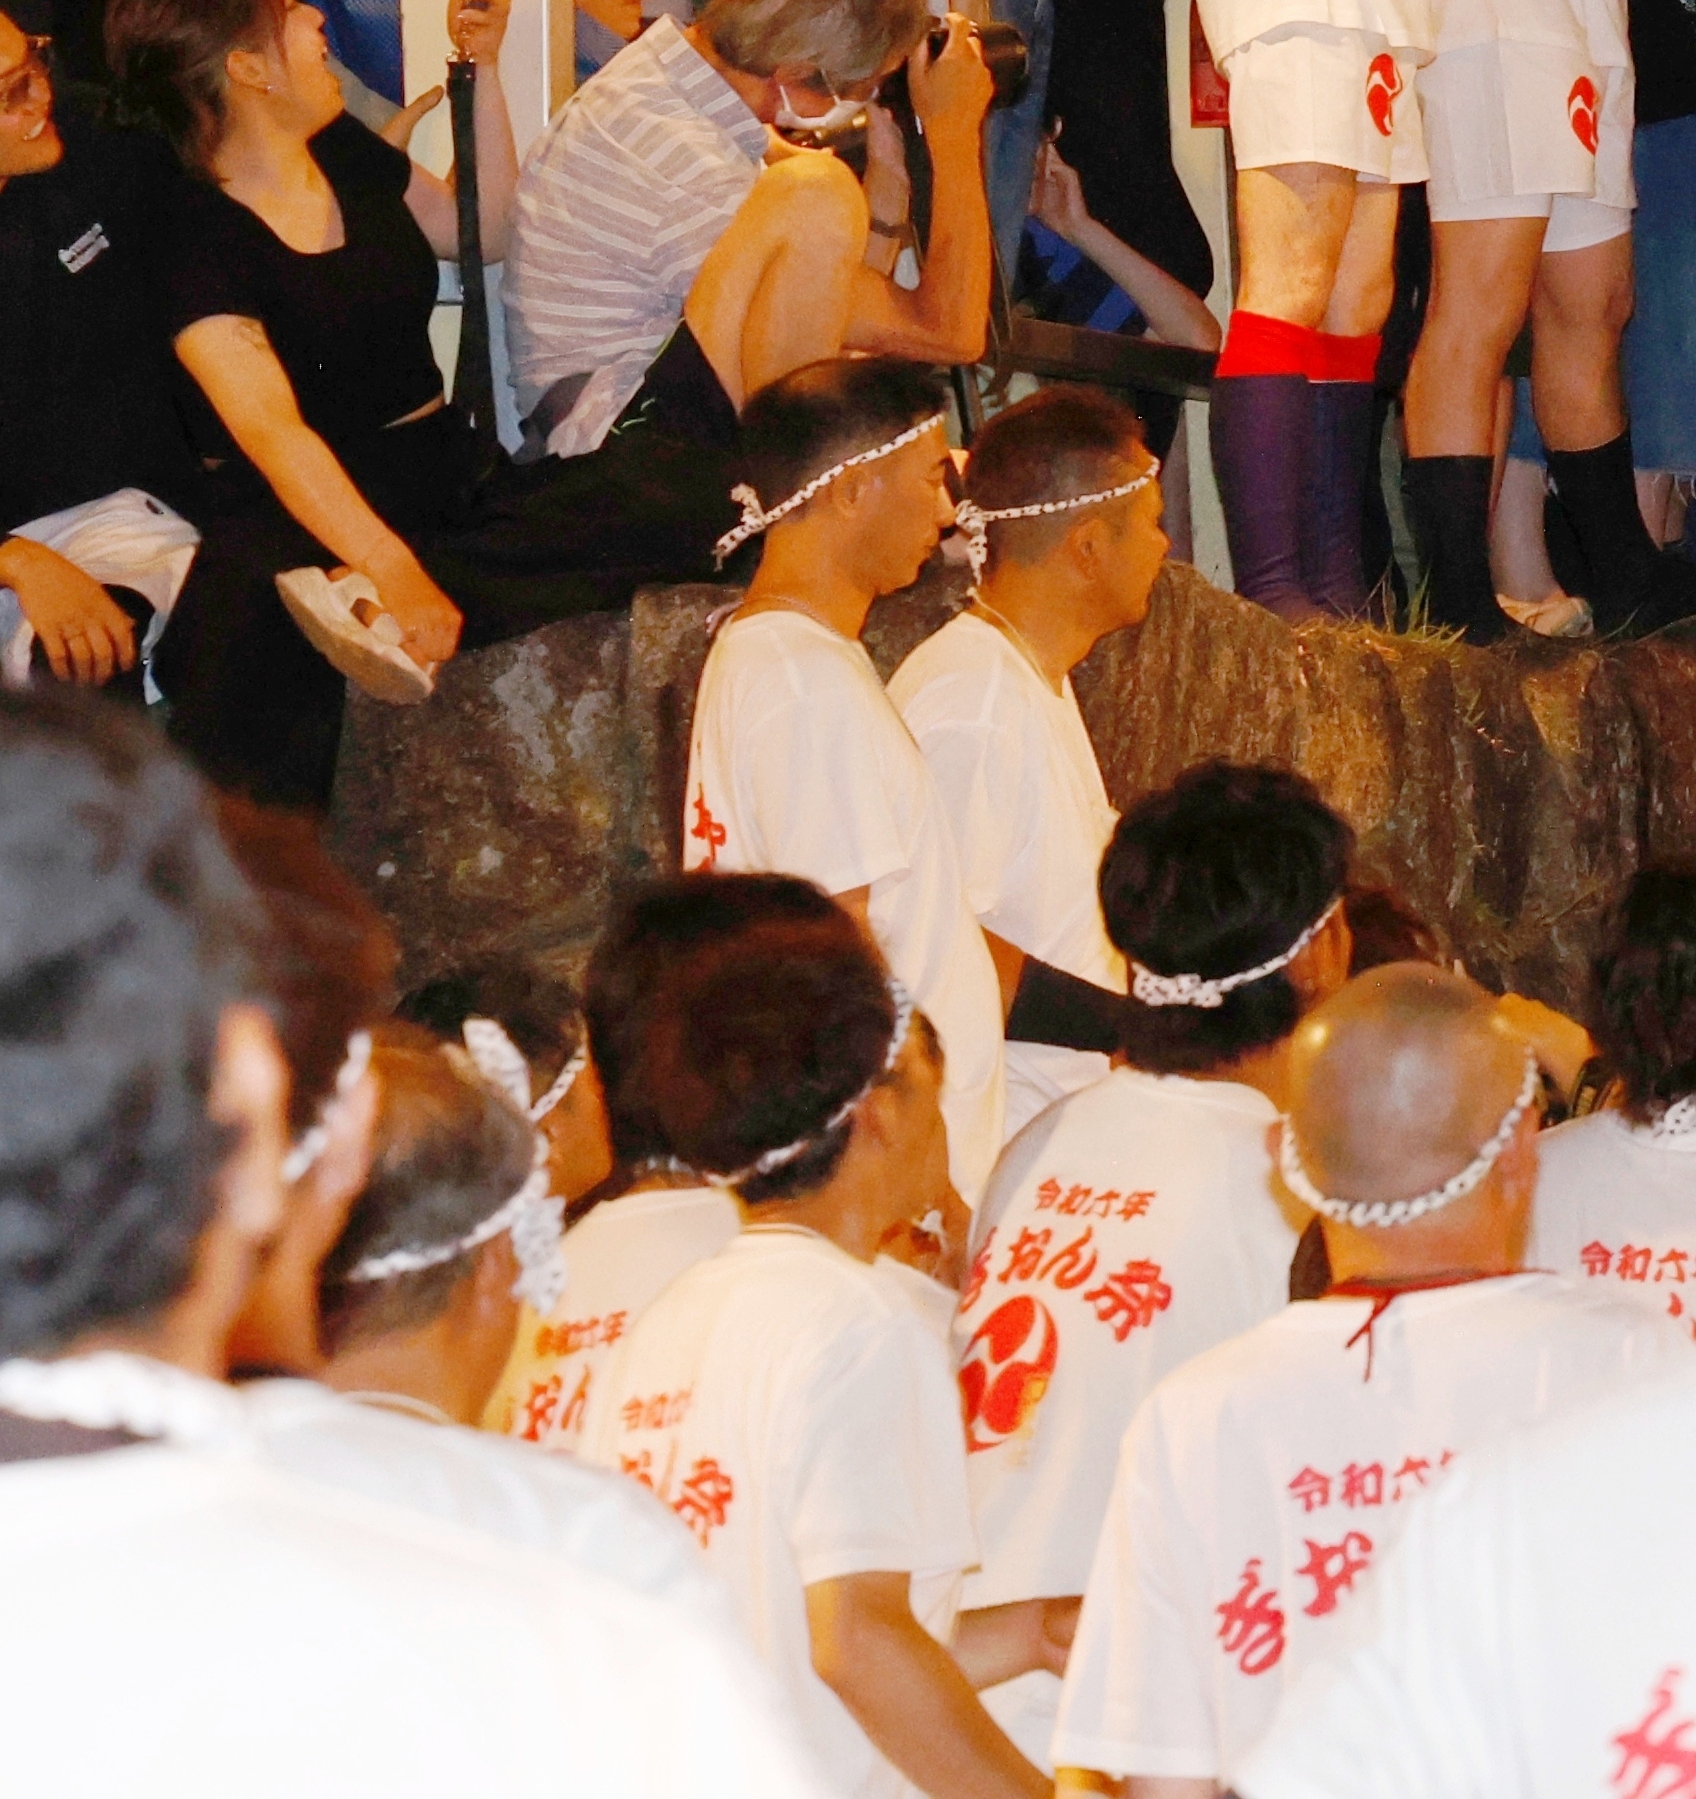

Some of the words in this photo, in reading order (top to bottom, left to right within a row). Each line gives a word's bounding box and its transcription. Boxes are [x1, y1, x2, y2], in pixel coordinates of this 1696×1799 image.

[1035, 1177, 1156, 1221] 令和六年
[1287, 1449, 1454, 1512] 令和六
